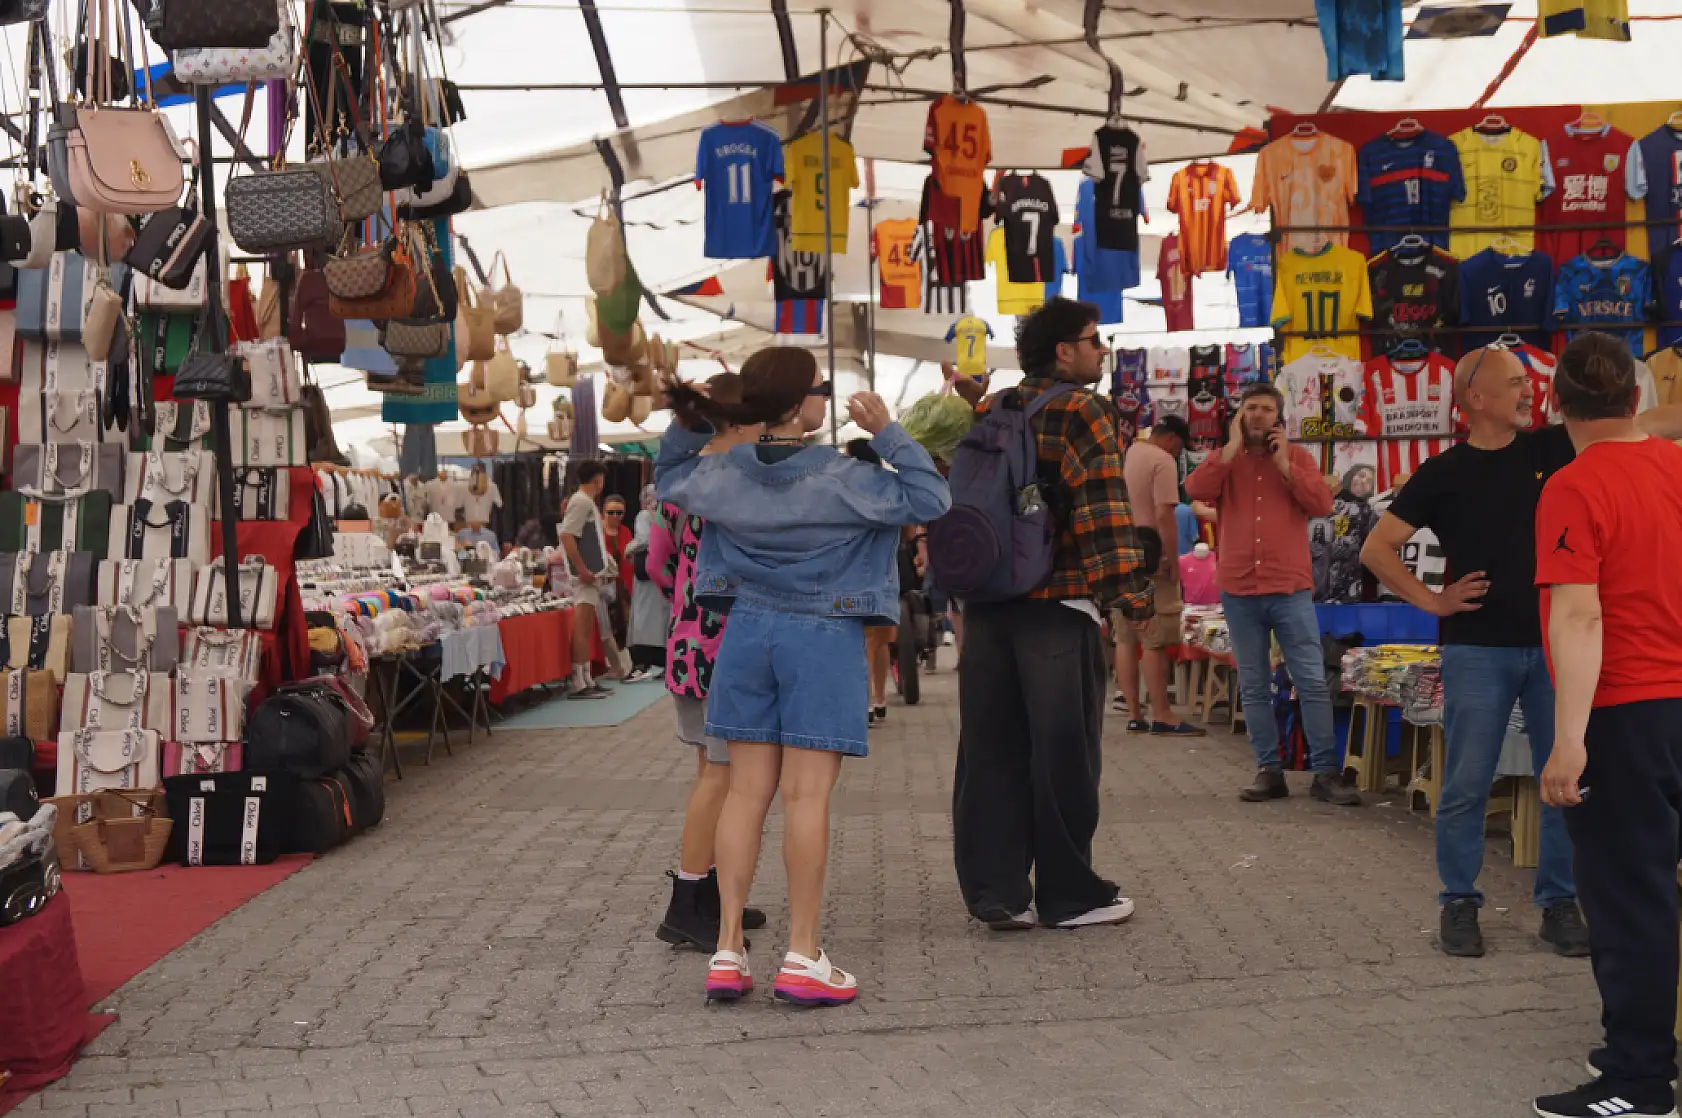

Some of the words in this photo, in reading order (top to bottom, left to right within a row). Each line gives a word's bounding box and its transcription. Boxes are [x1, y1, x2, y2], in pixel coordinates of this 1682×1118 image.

[944, 122, 977, 158] 45
[728, 162, 751, 203] 11
[1110, 161, 1128, 205] 7
[1021, 212, 1040, 255] 7
[1302, 290, 1341, 341] 10
[1487, 292, 1507, 317] 10
[965, 334, 976, 358] 7
